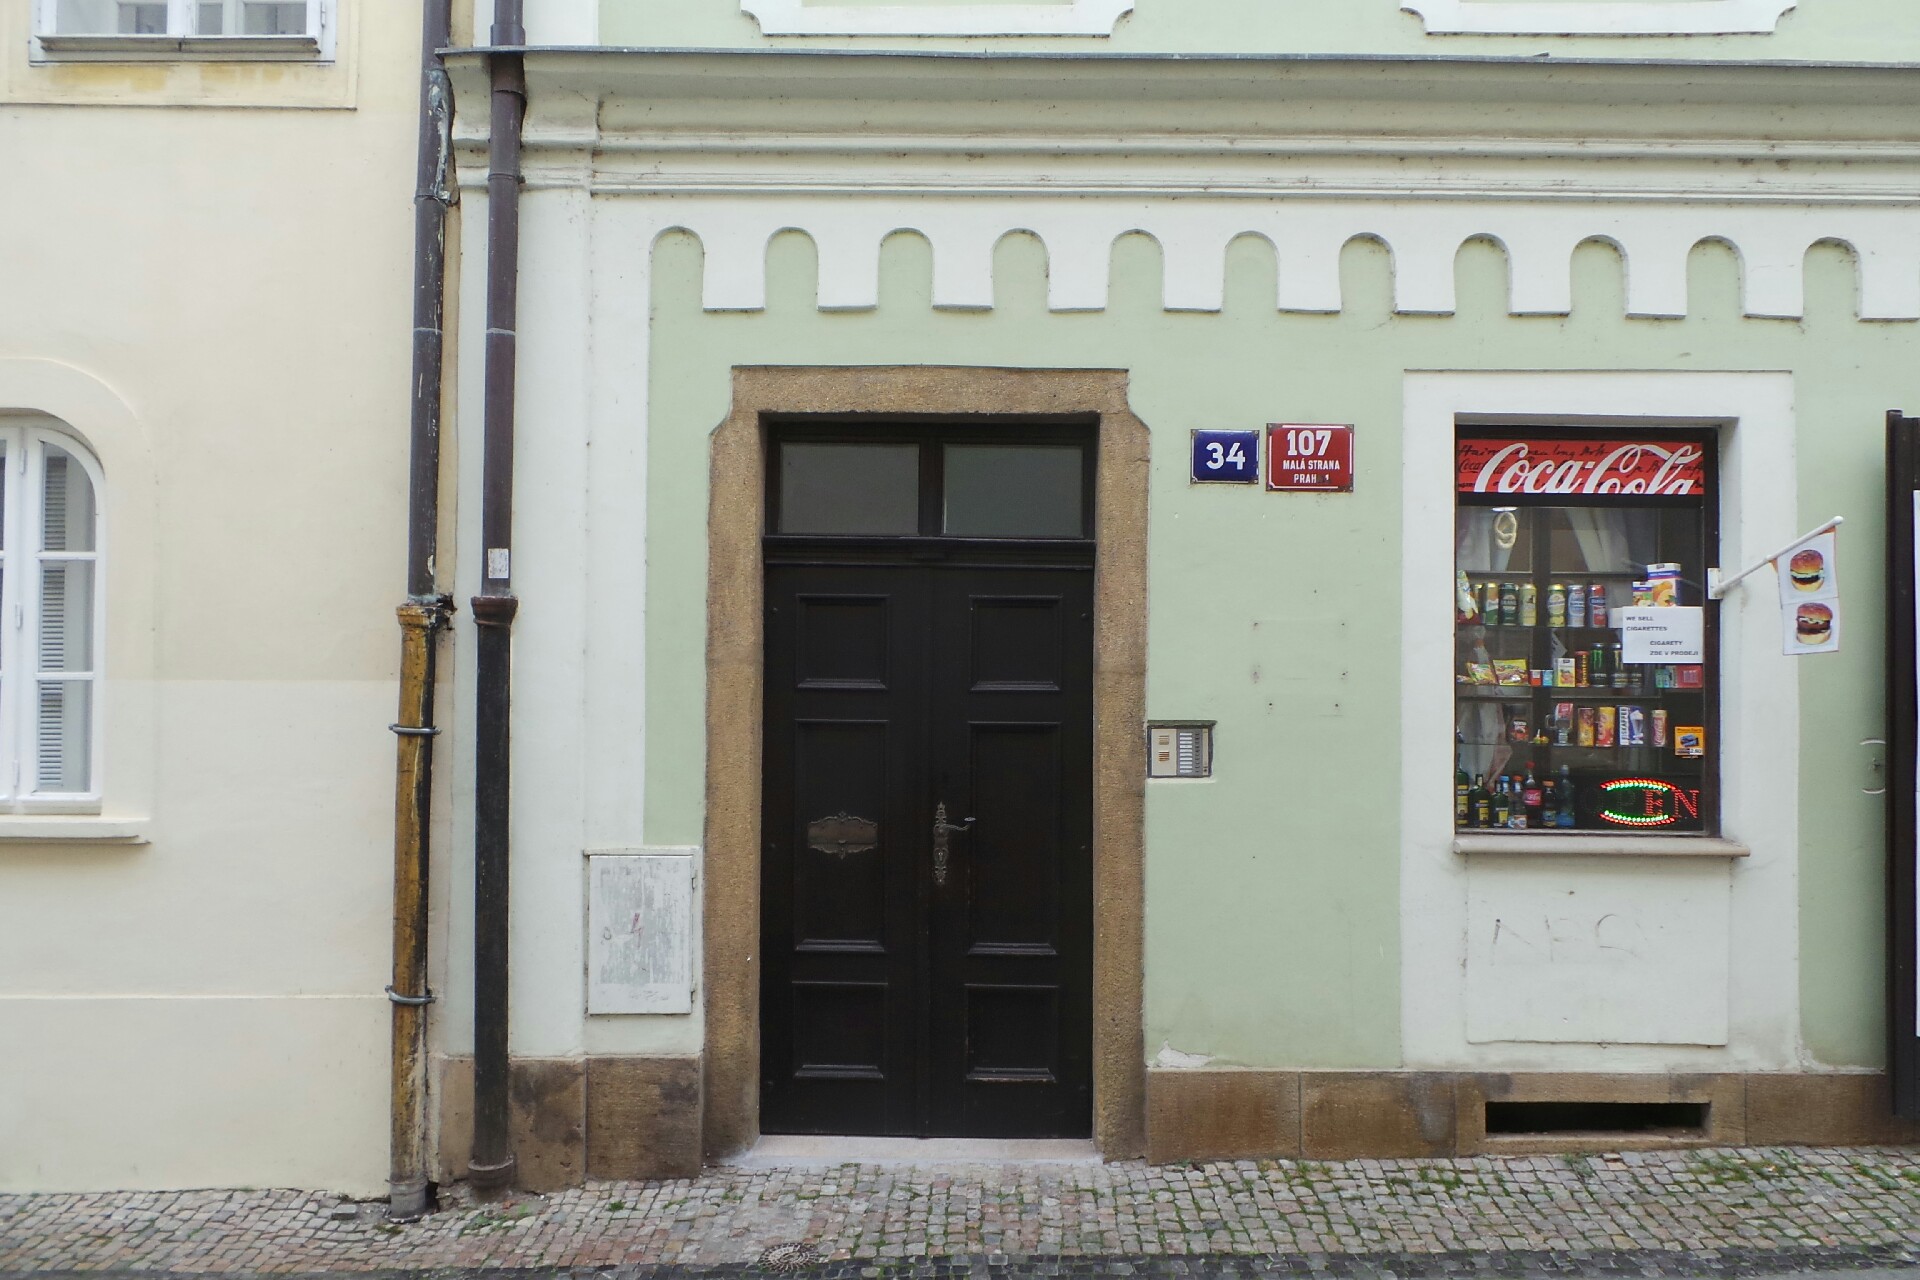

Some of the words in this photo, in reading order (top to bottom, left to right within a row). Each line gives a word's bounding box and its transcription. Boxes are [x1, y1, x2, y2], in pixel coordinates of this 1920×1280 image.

[1205, 442, 1246, 470] 34
[1287, 429, 1332, 456] 107
[1283, 457, 1306, 470] MALÁ
[1308, 459, 1341, 470] STRANA
[1473, 442, 1703, 494] Coca-Cola
[1293, 473, 1323, 484] PRAH
